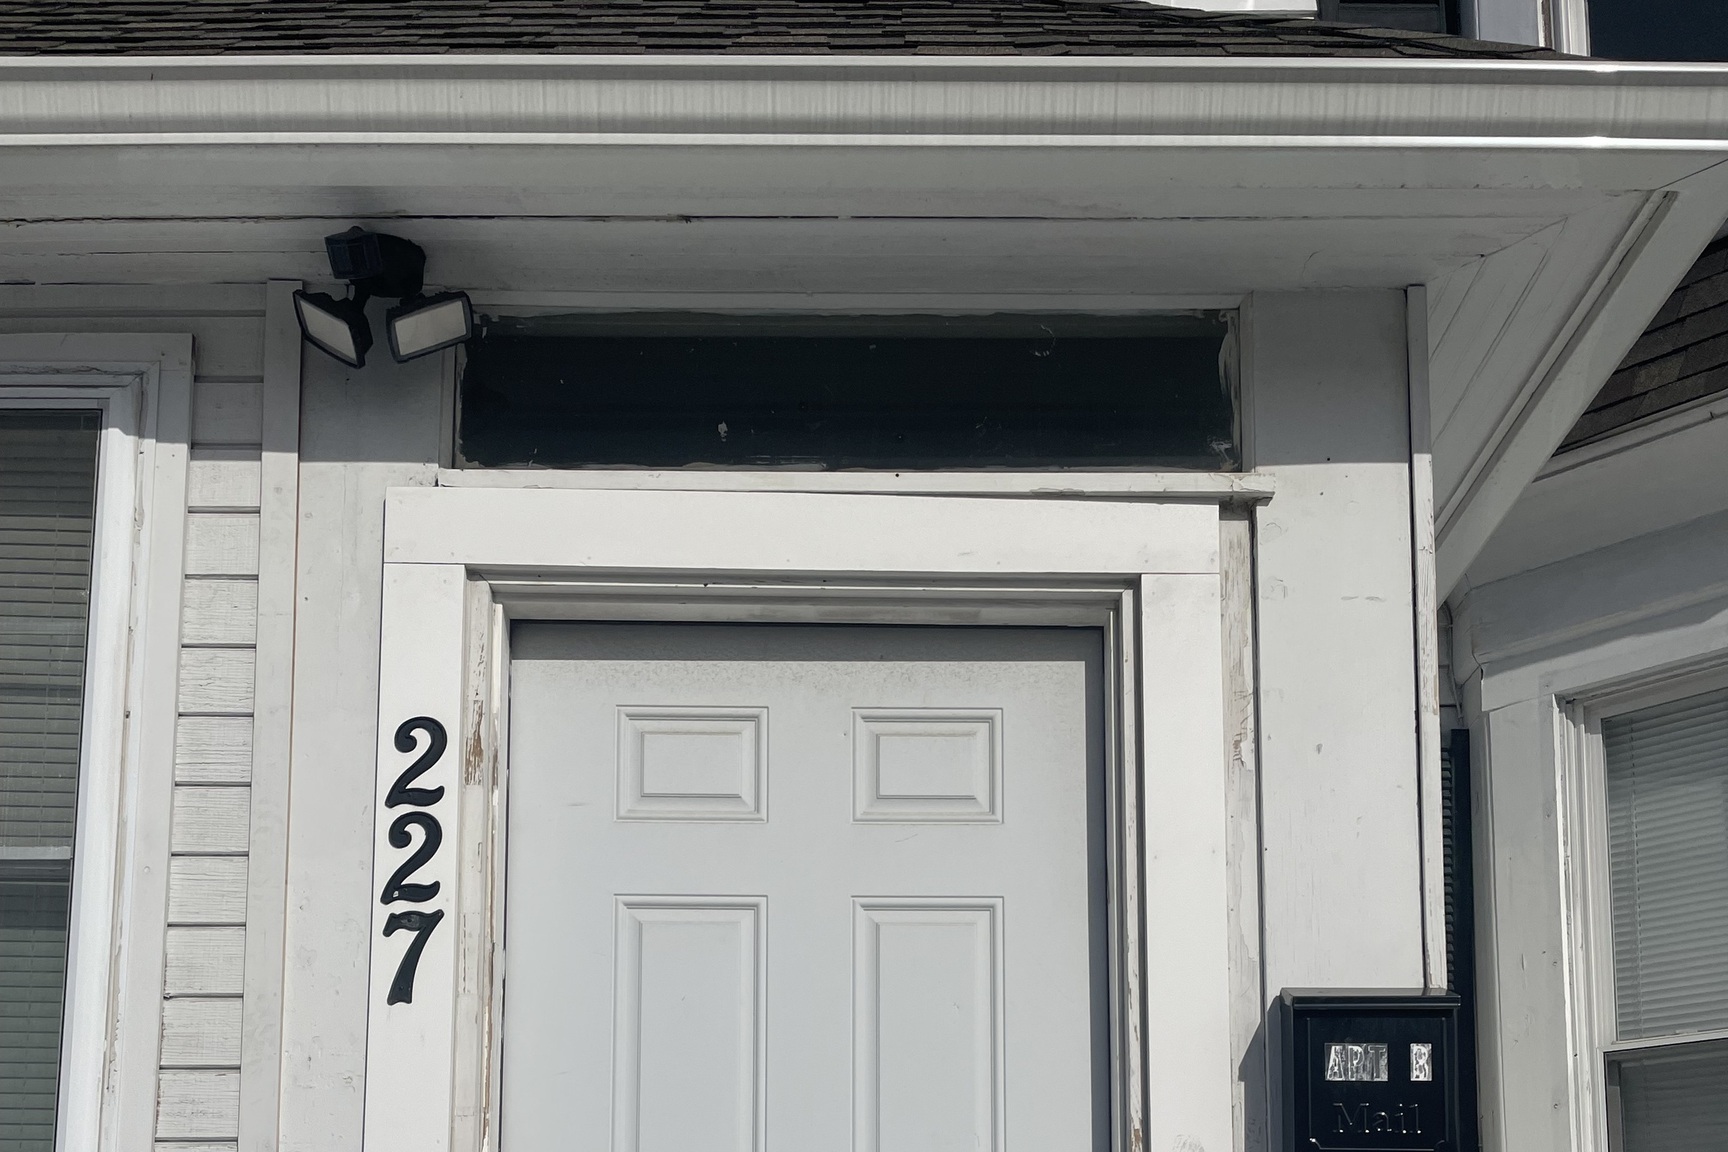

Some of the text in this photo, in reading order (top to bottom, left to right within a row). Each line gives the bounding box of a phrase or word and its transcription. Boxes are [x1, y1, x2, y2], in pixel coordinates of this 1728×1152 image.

[380, 716, 448, 1006] 227
[1326, 1043, 1387, 1080] APT
[1332, 1102, 1422, 1133] Mail
